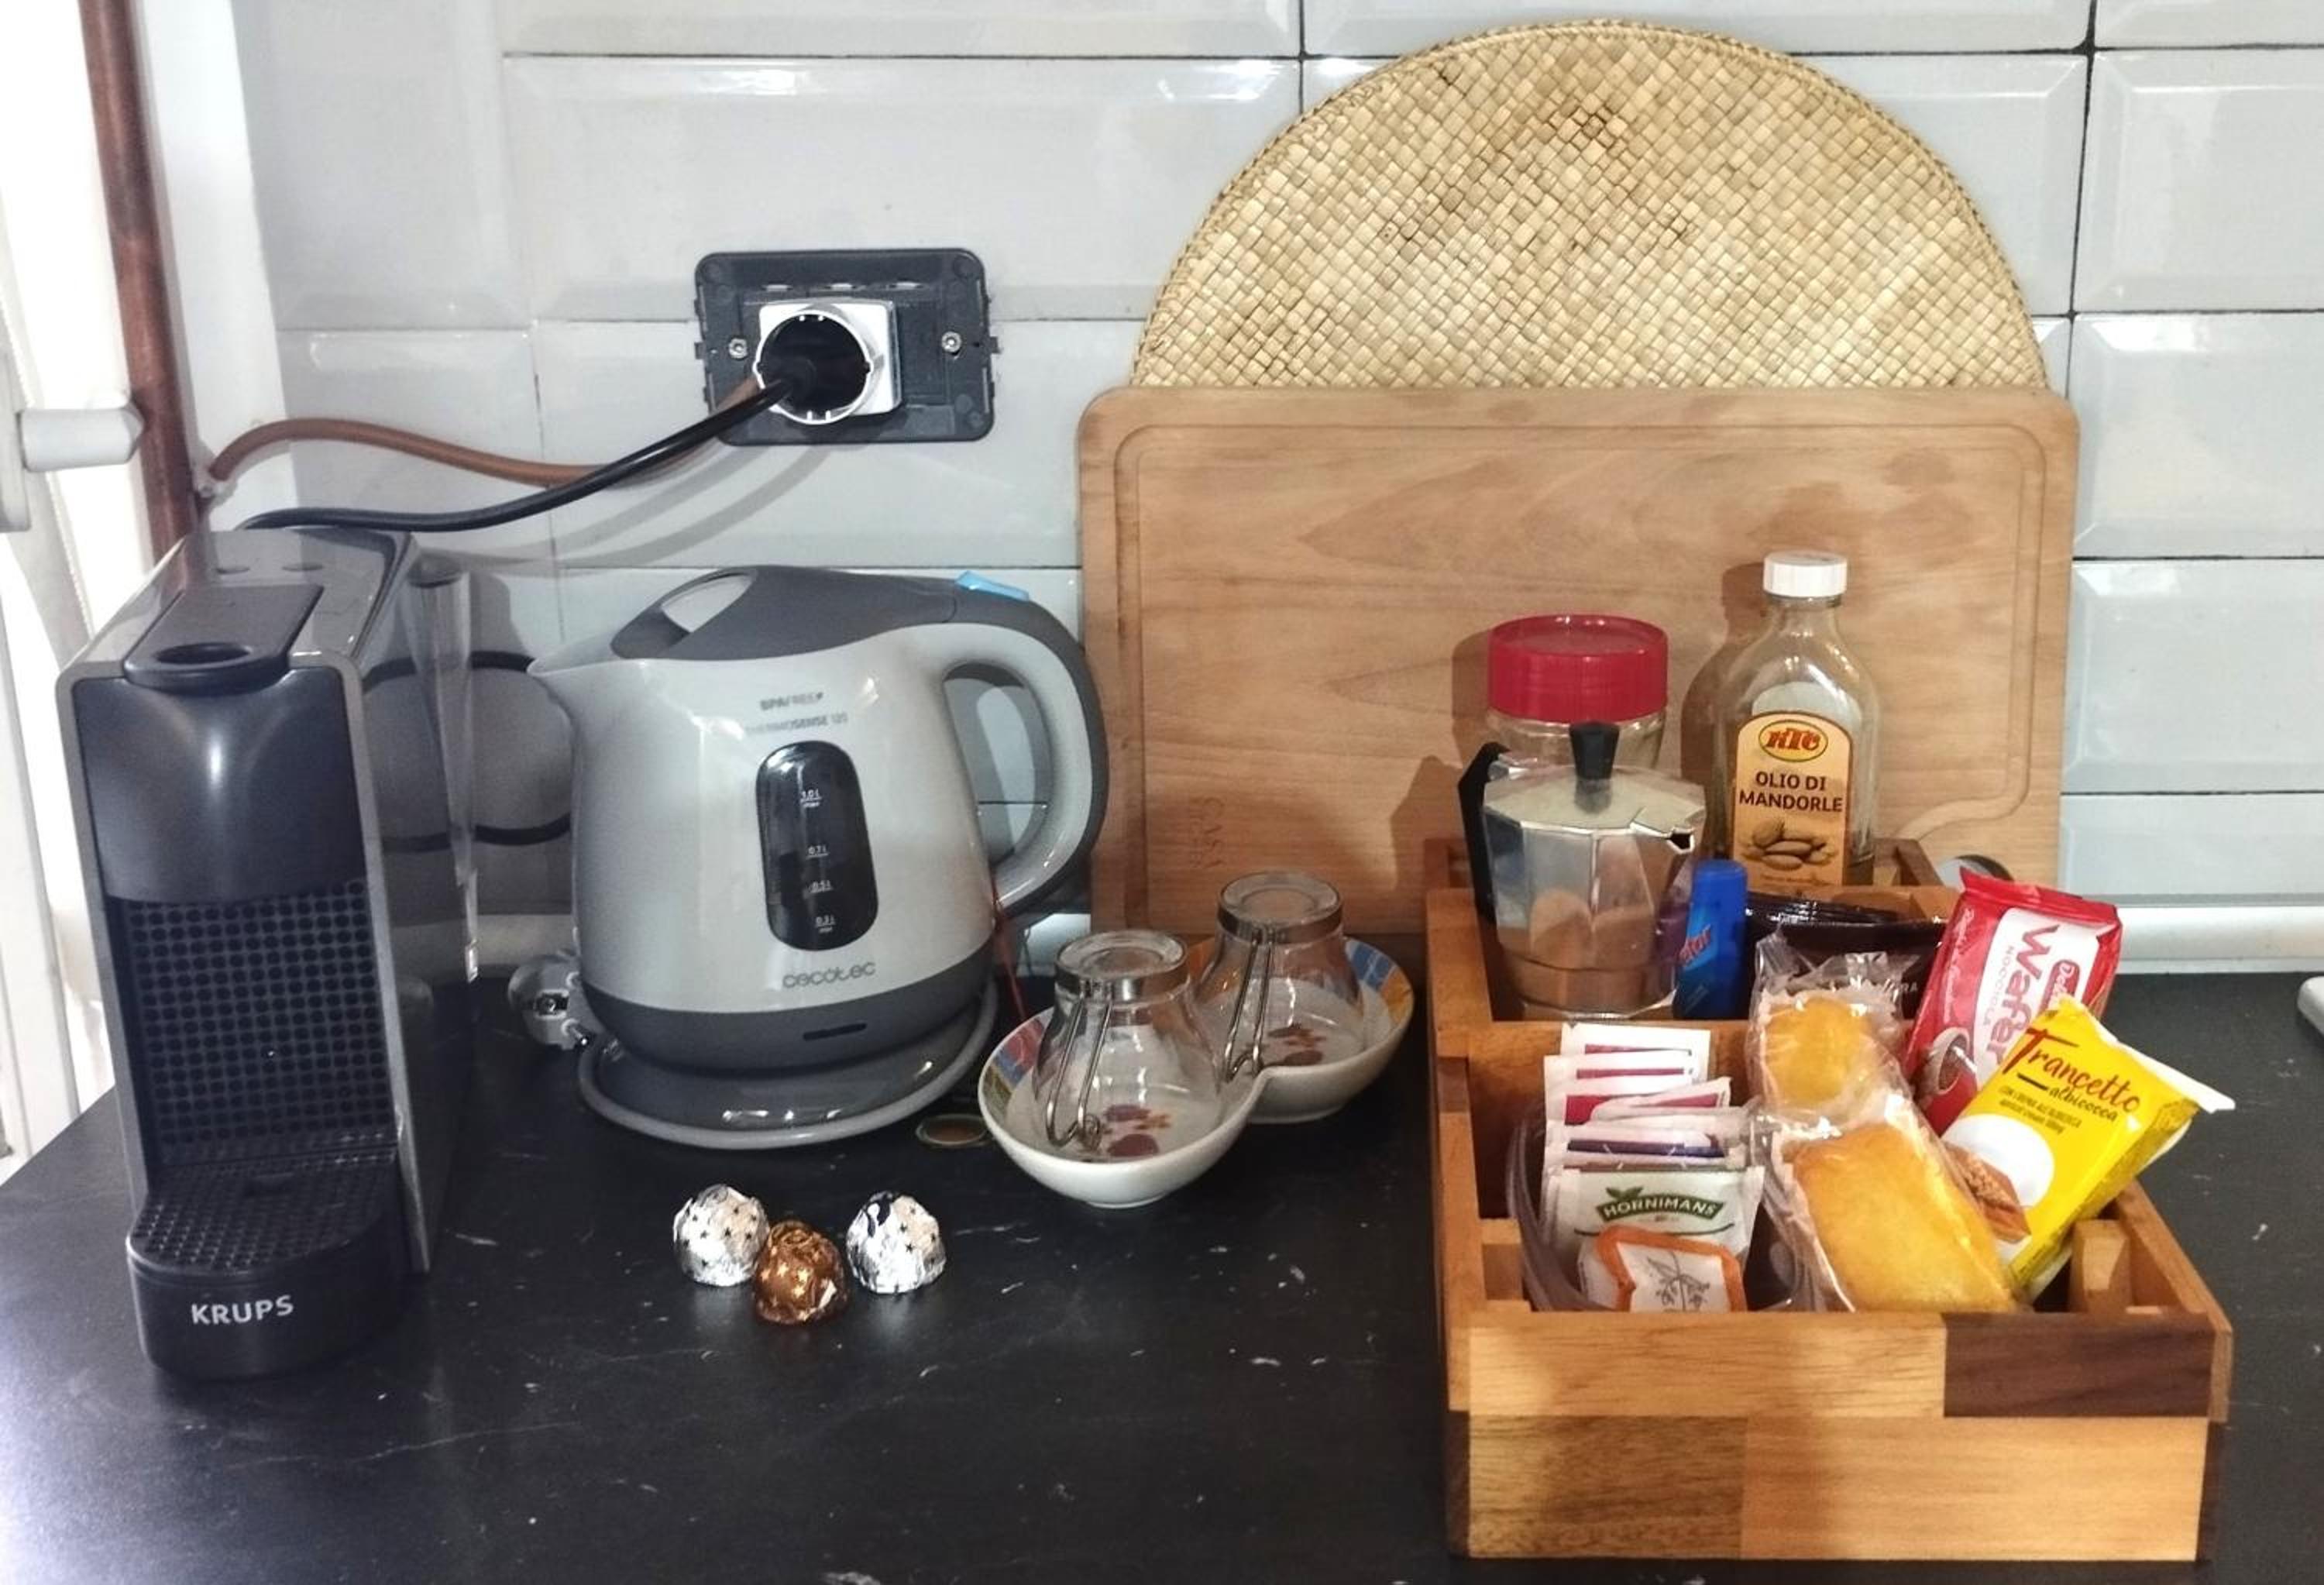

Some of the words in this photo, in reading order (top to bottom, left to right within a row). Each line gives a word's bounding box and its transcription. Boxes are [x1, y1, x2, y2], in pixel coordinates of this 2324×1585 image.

[1755, 771, 1800, 789] OLIO
[1805, 775, 1827, 791] DI
[1738, 789, 1844, 813] MANDORLE
[782, 961, 876, 989] cecotec
[1985, 923, 2061, 1065] Wafer
[2002, 1027, 2140, 1114] Trancetto
[2047, 1085, 2119, 1123] albicocca
[1603, 1197, 1715, 1218] HORNIMANS
[191, 1294, 294, 1325] KRUPS
